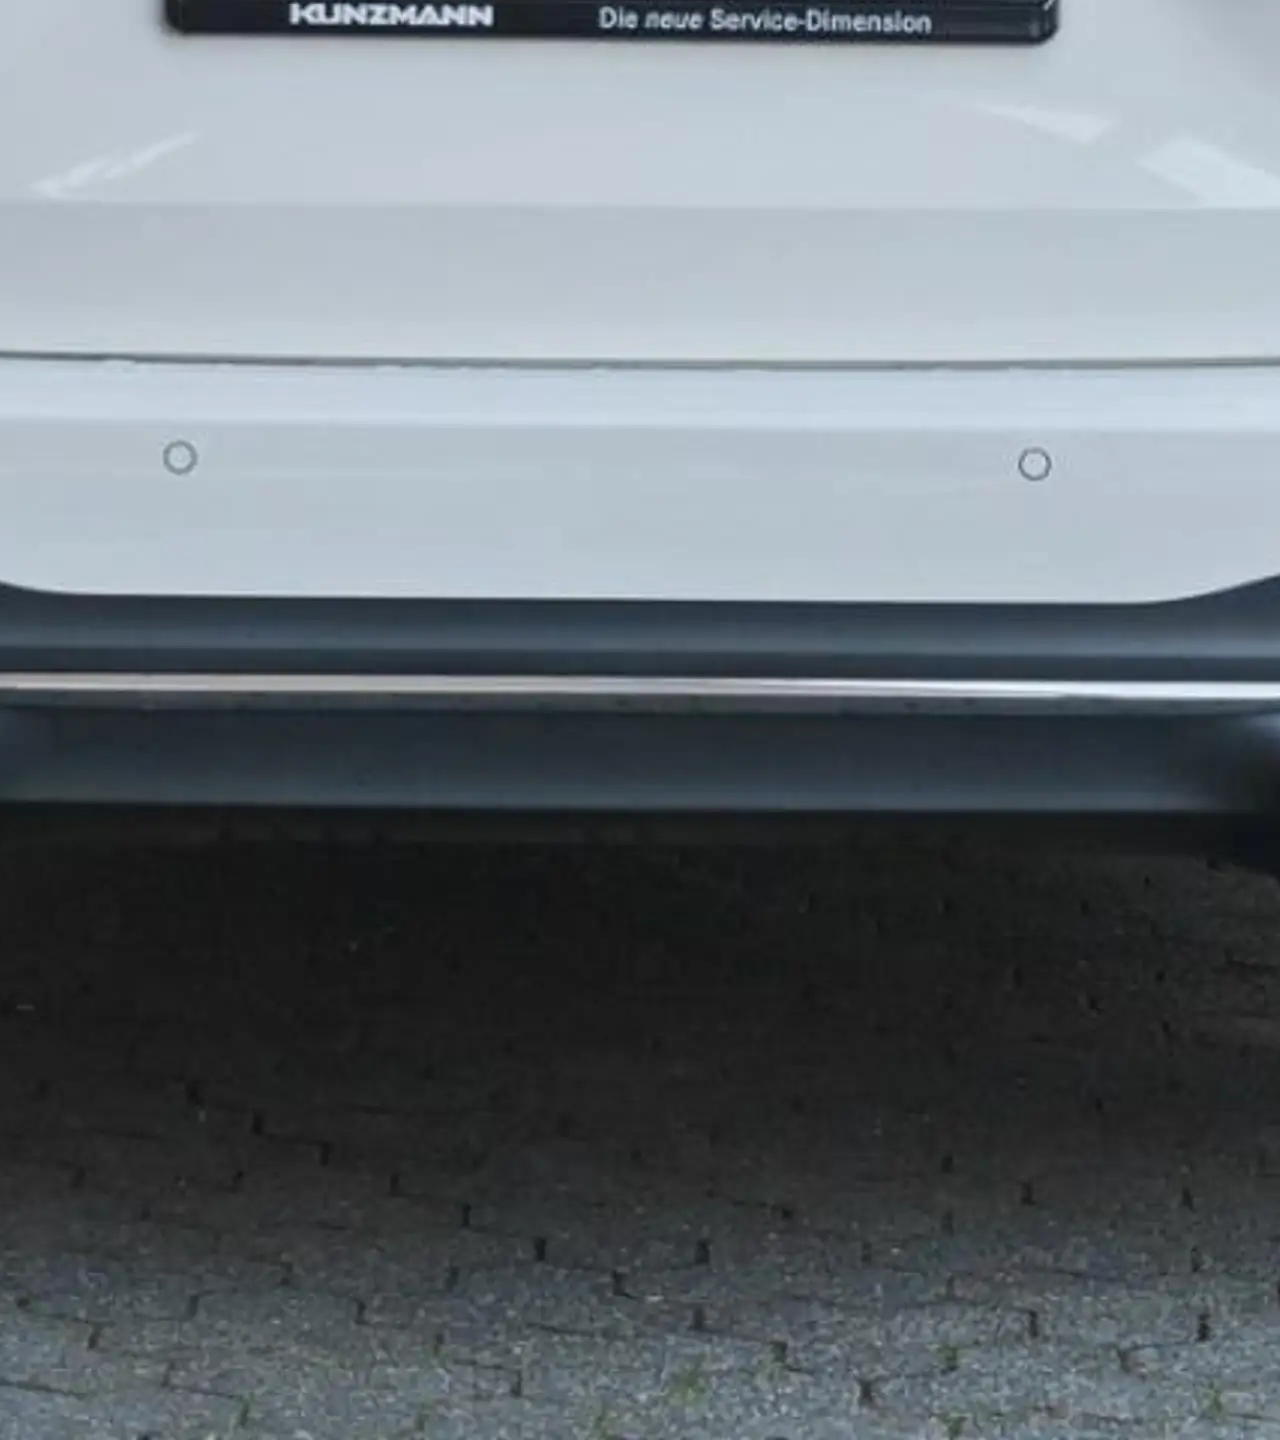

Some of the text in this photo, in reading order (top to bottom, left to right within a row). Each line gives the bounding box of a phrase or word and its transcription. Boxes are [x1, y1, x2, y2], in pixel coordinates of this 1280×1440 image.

[289, 2, 494, 27] KUNZMANN
[599, 6, 933, 34] Die neue Service-Dimension
